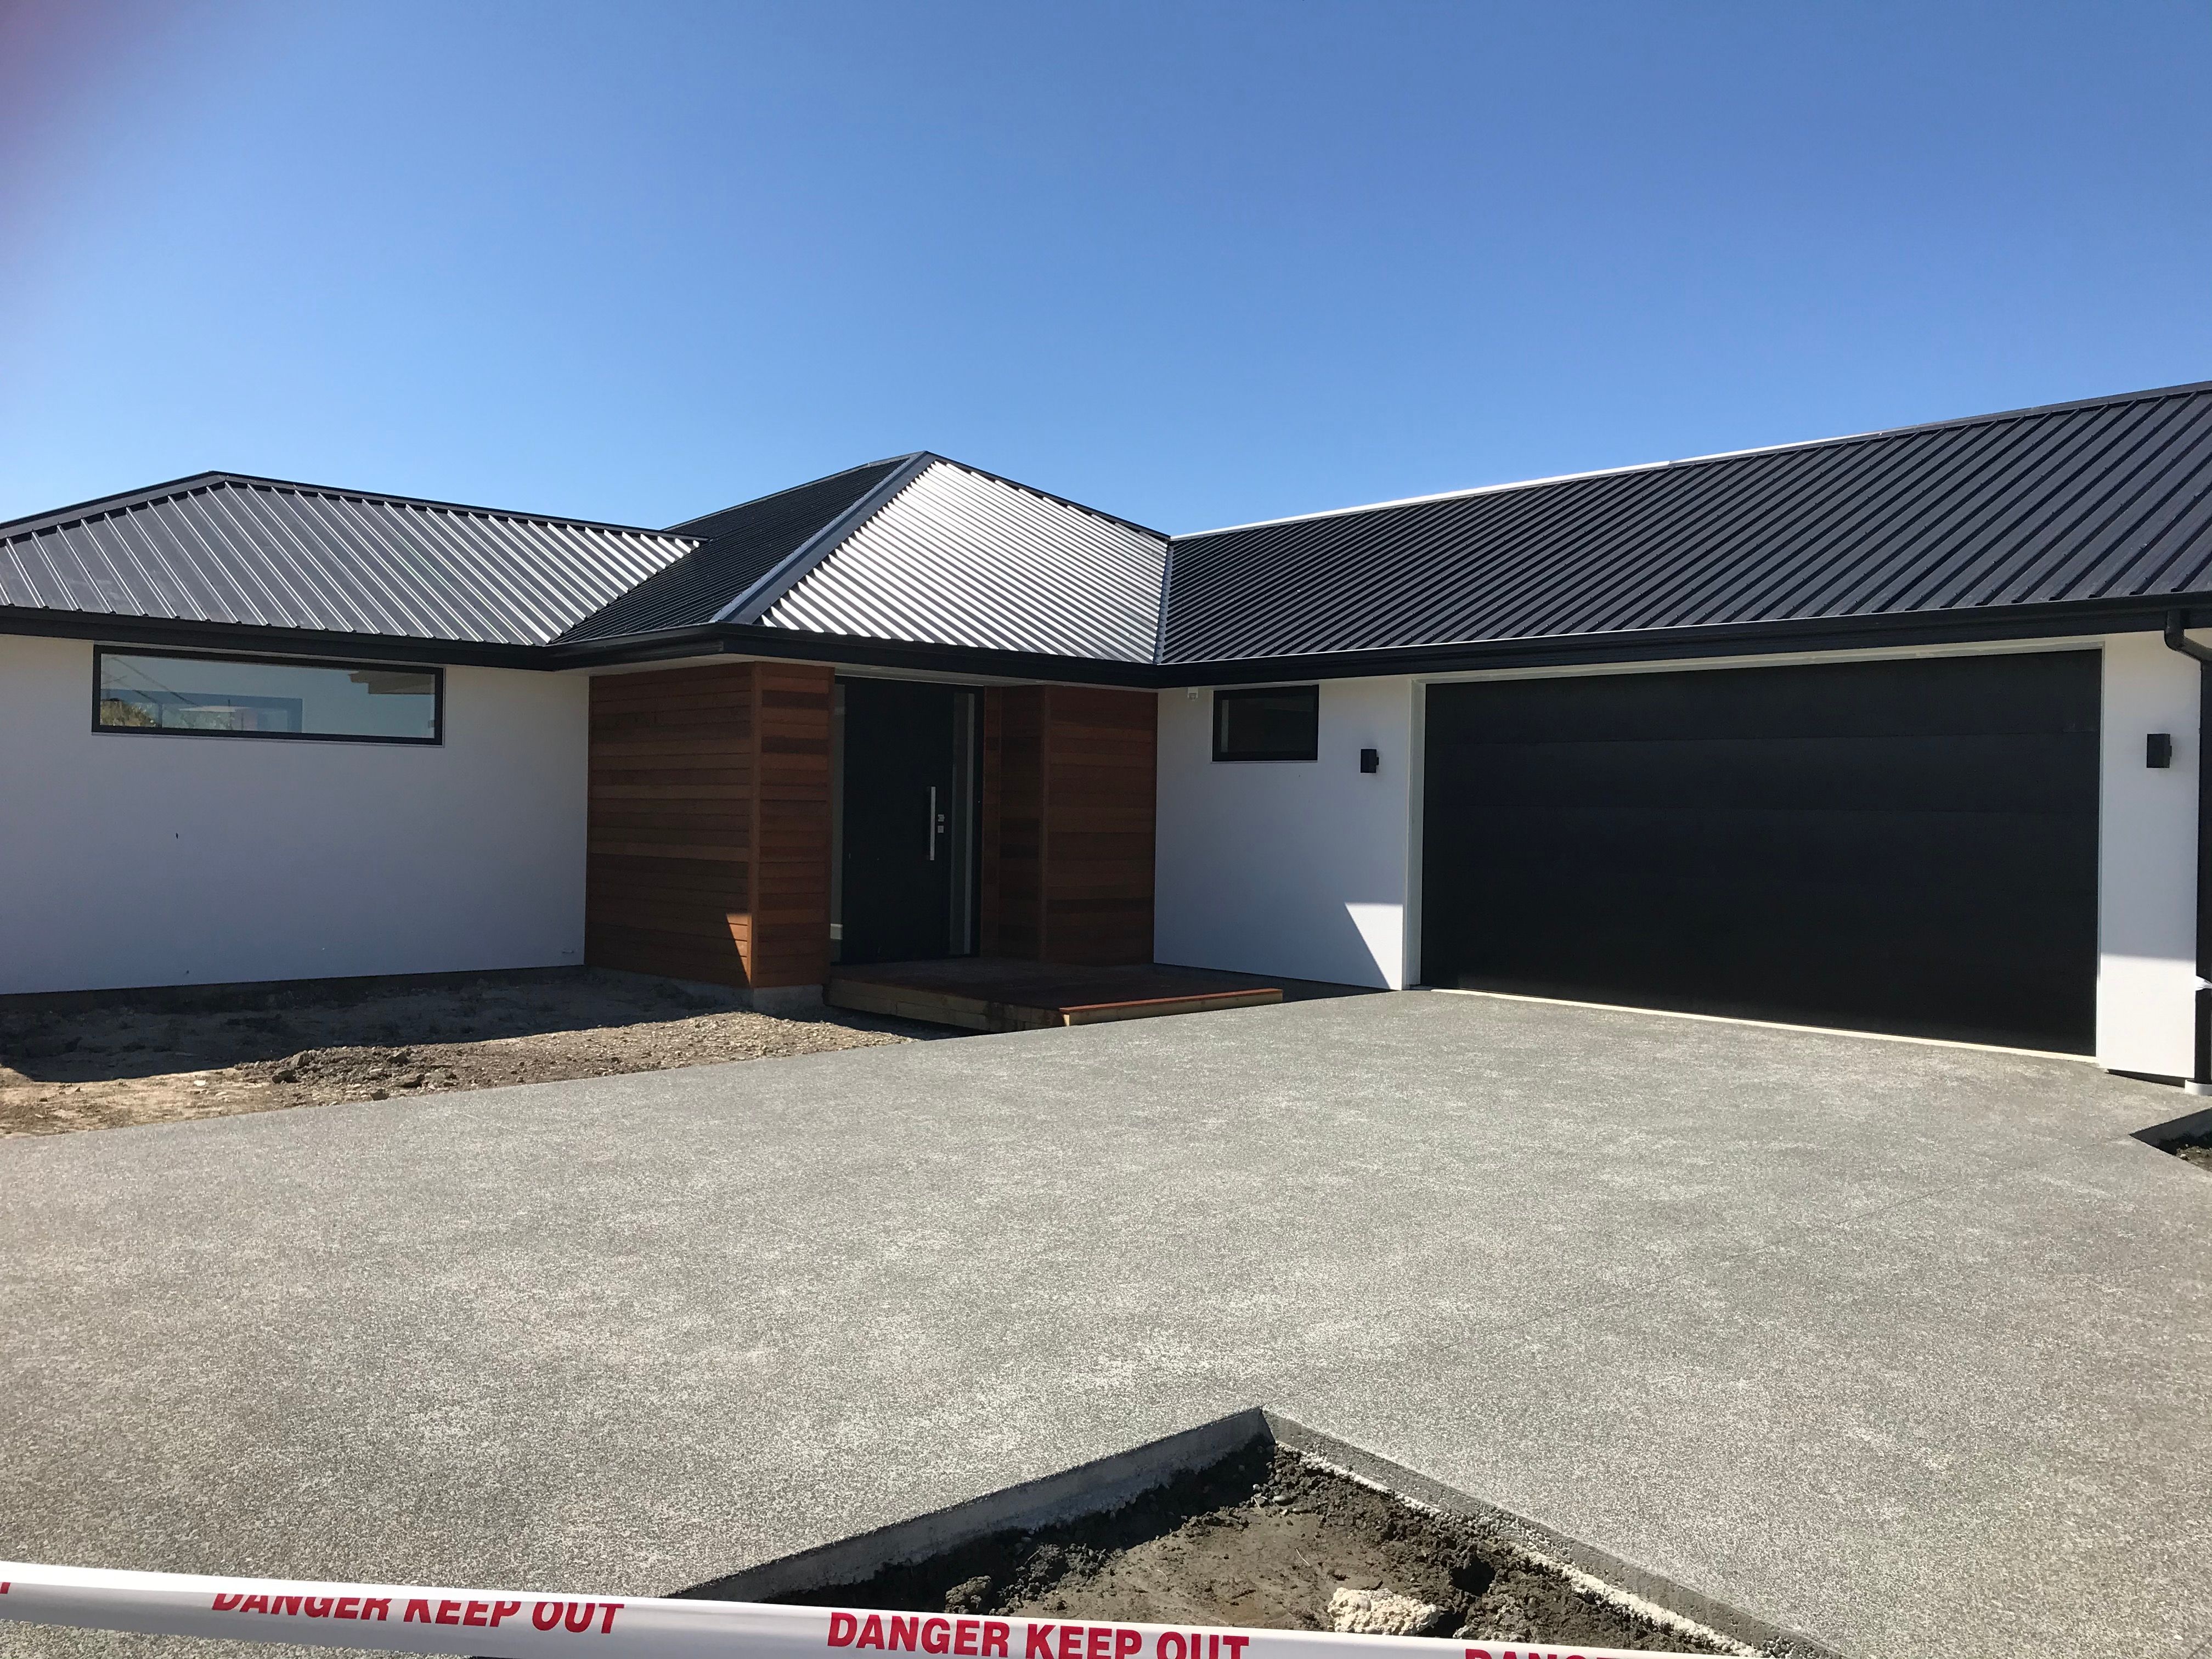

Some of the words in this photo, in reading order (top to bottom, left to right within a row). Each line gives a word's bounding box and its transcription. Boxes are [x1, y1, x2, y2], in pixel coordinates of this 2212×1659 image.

[403, 1599, 522, 1627] KEEP
[532, 1601, 624, 1633] OUT
[827, 1612, 1011, 1657] DANGER
[1025, 1623, 1143, 1659] KEEP
[1156, 1631, 1250, 1659] OUT
